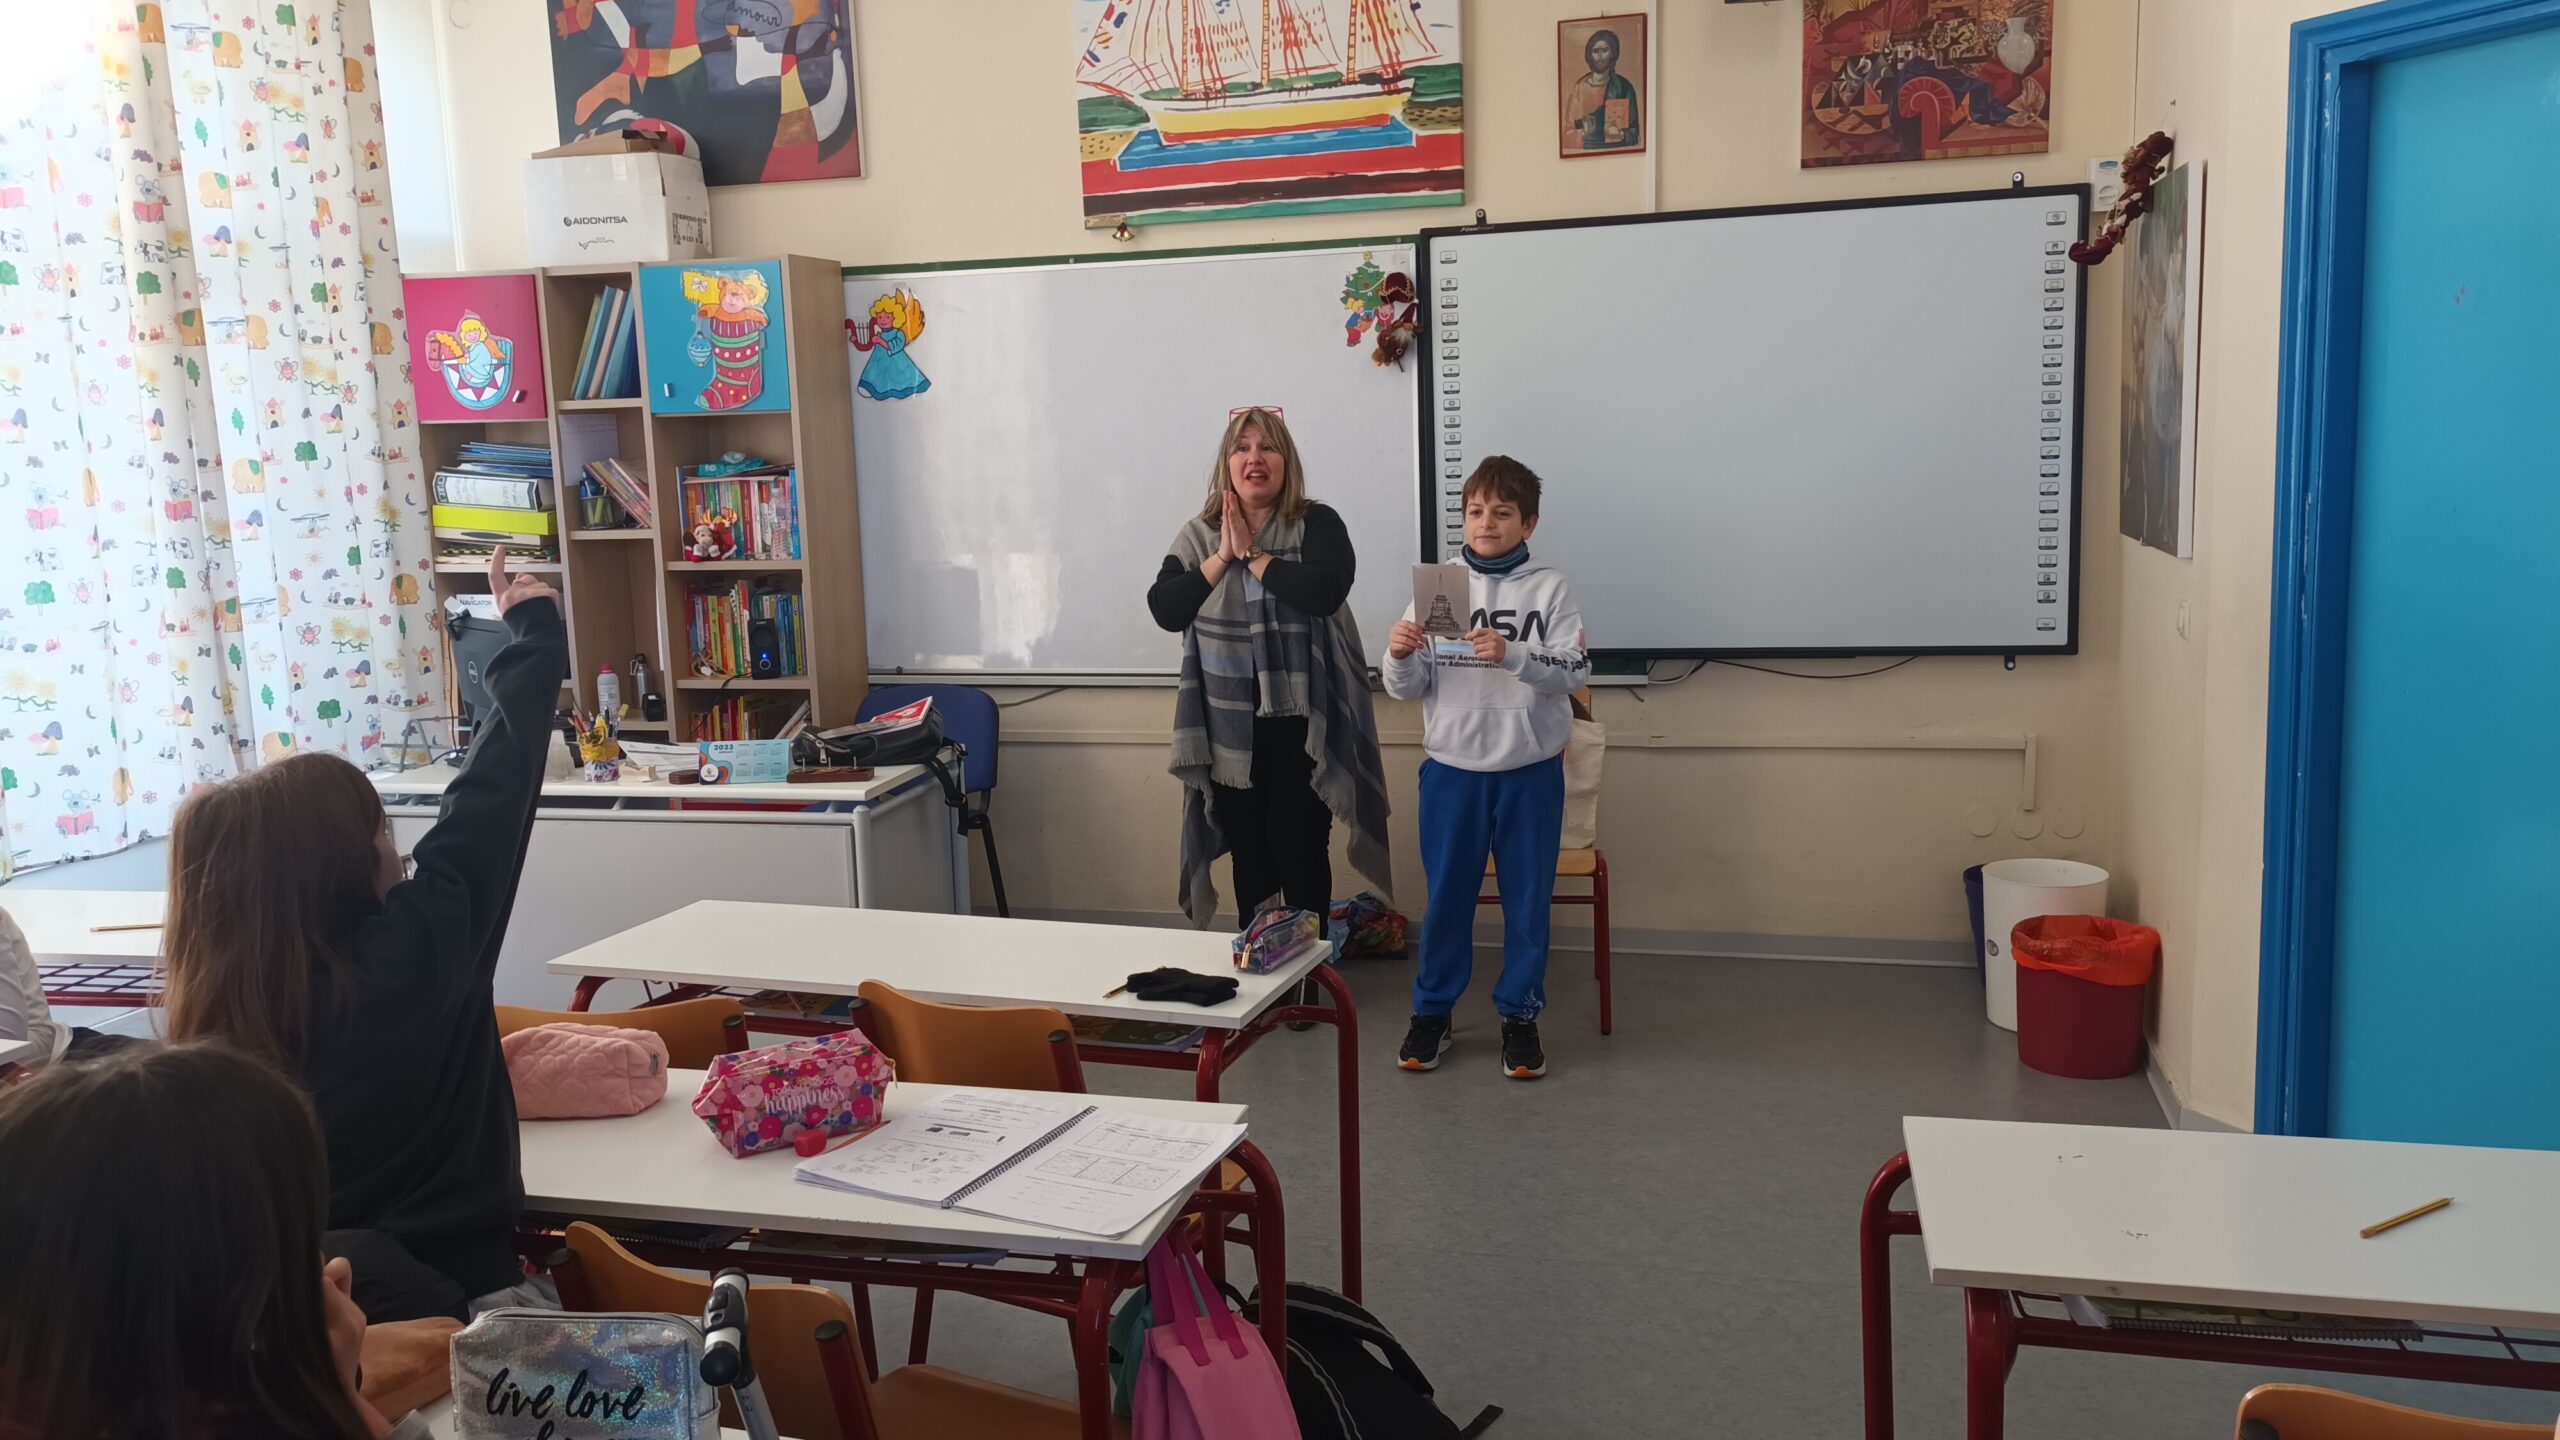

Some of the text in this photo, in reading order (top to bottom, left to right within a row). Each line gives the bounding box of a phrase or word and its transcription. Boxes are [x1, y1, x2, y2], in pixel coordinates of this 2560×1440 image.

[573, 216, 628, 225] AIDONITSA
[1445, 608, 1544, 642] ASA
[764, 1085, 845, 1116] happiness
[486, 1368, 645, 1421] live love
